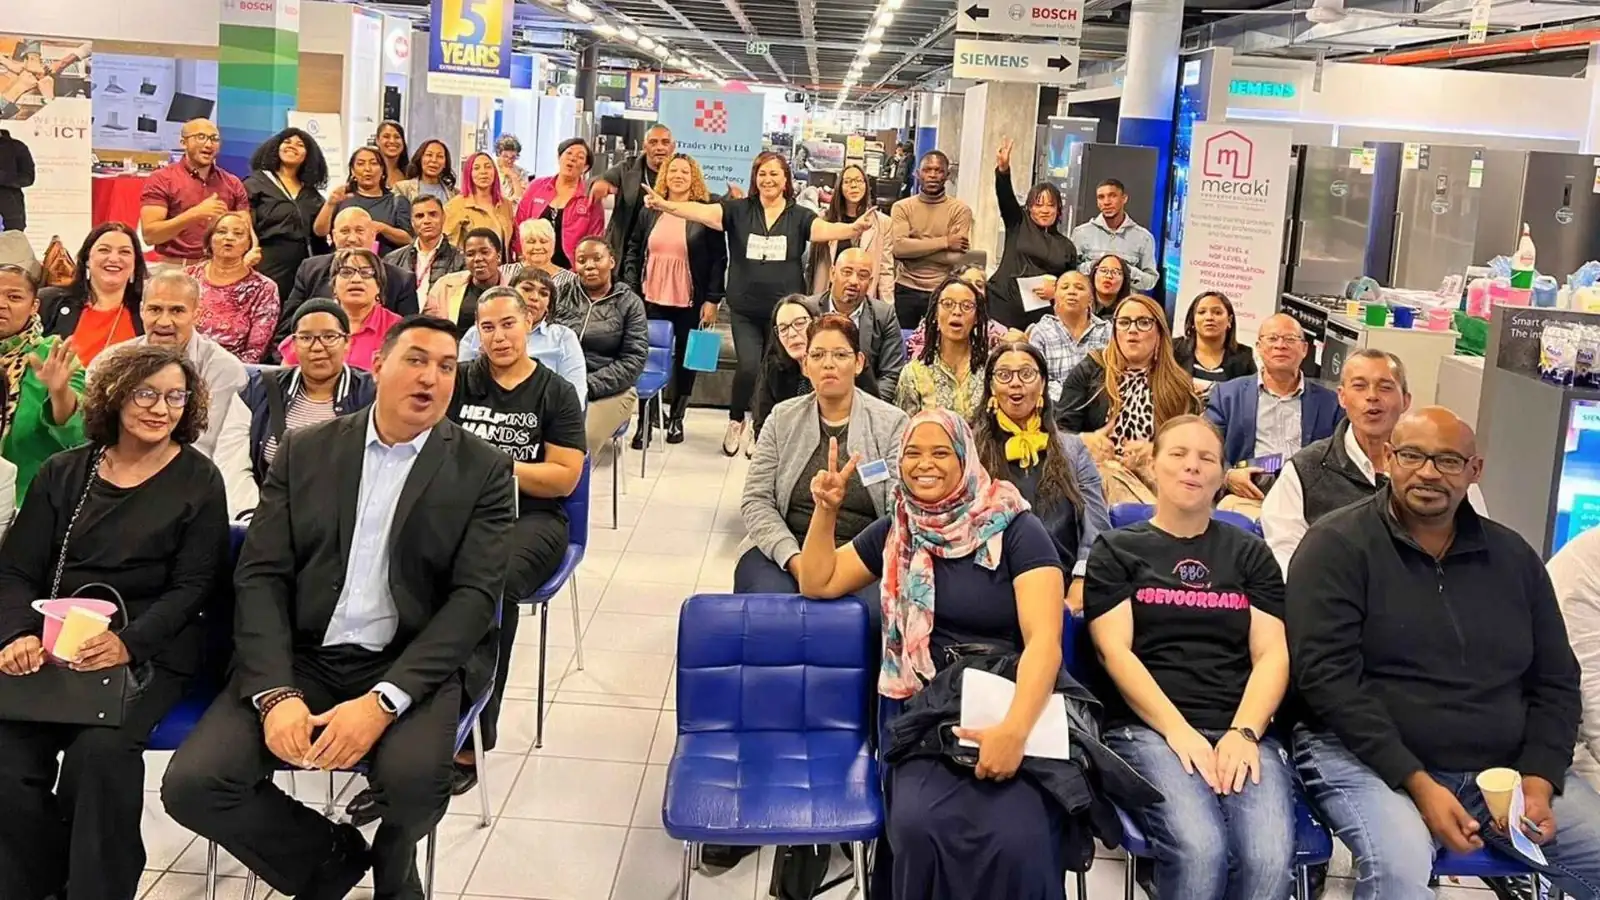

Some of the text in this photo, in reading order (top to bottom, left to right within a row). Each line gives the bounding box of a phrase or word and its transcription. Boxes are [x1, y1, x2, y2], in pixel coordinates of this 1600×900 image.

[240, 1, 272, 11] BOSCH
[1032, 7, 1077, 20] BOSCH
[457, 0, 486, 45] 5
[441, 41, 501, 68] YEARS
[960, 53, 1029, 68] SIEMENS
[637, 78, 649, 99] 5
[1229, 79, 1296, 98] IEMENS
[630, 96, 655, 108] YEARS
[734, 144, 750, 152] Ltd
[717, 164, 733, 172] stop
[1201, 179, 1270, 197] meraki
[1512, 316, 1539, 327] Smart
[1511, 328, 1528, 338] The
[459, 404, 538, 428] HELPING
[462, 421, 530, 445] HANDS
